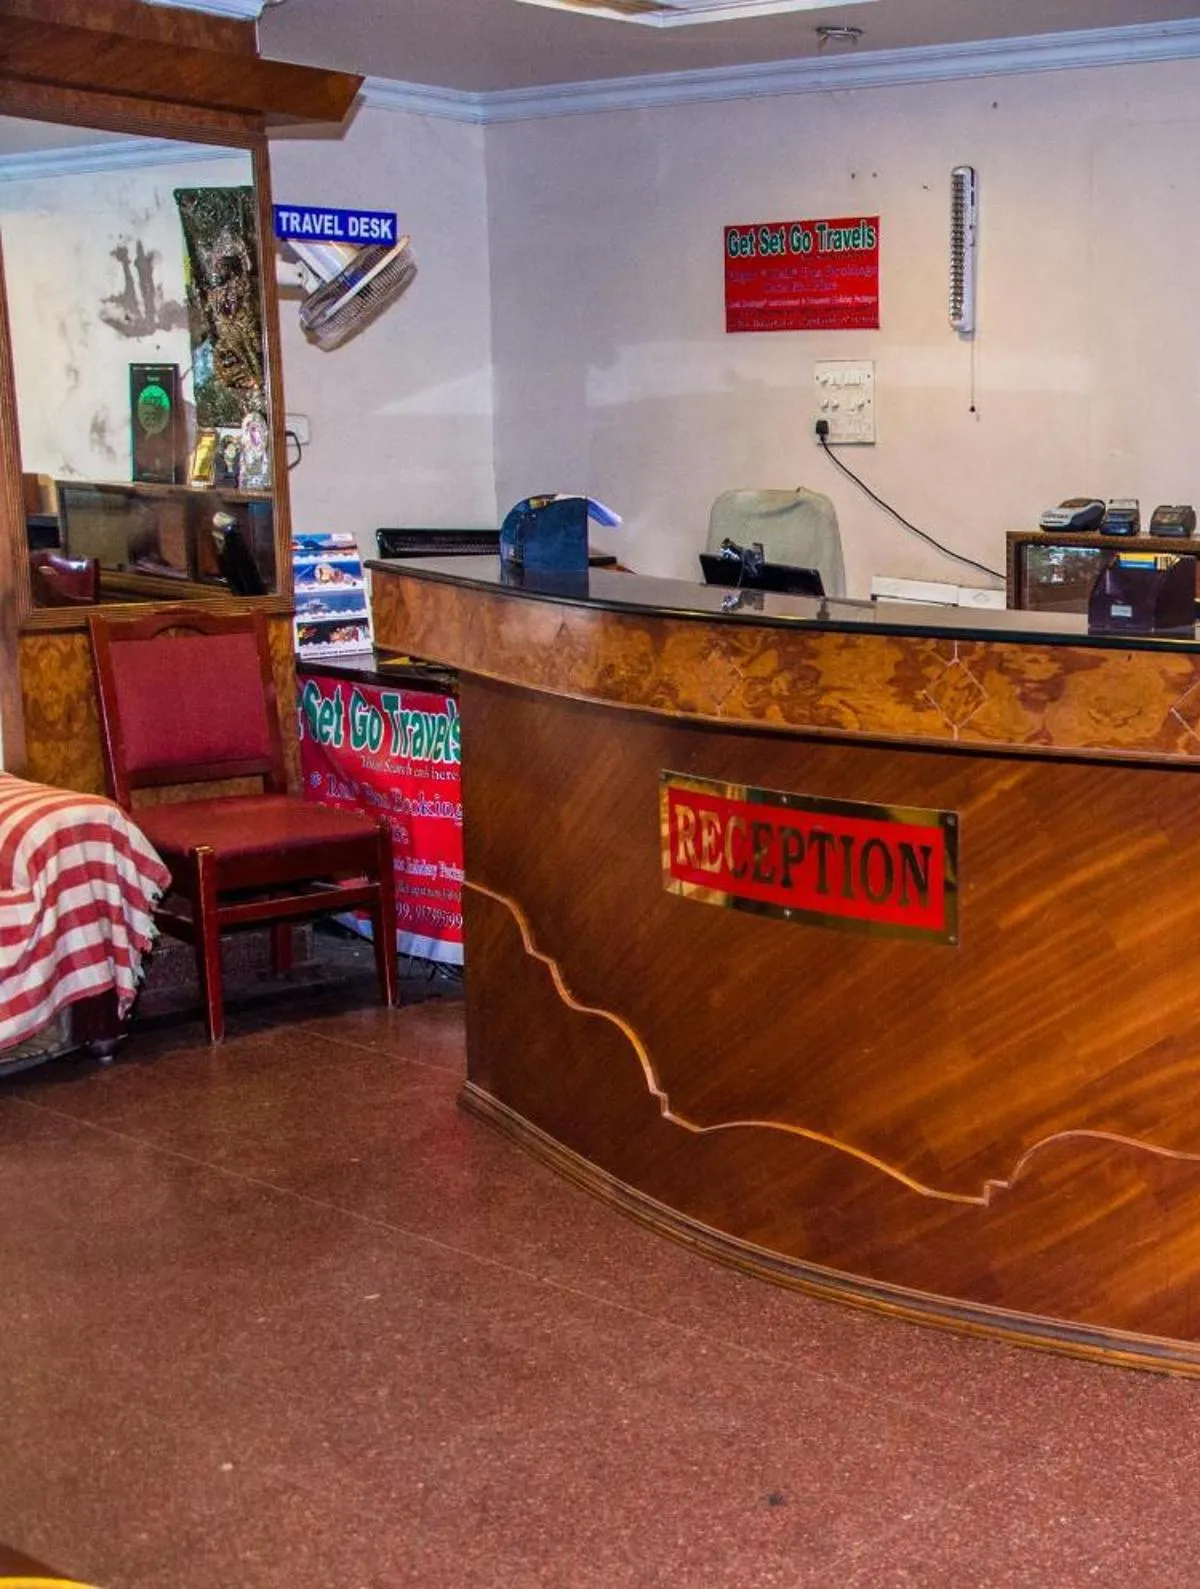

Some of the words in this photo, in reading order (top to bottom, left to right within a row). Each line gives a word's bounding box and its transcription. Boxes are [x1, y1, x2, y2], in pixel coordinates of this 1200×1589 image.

[278, 211, 344, 236] TRAVEL
[348, 217, 393, 239] DESK
[728, 228, 755, 258] Get
[758, 226, 787, 256] Set
[790, 224, 813, 254] Go
[815, 220, 876, 253] Travels
[303, 680, 345, 748] Set
[350, 687, 385, 753] Go
[382, 693, 462, 763] Travels
[675, 804, 932, 907] RECEPTION
